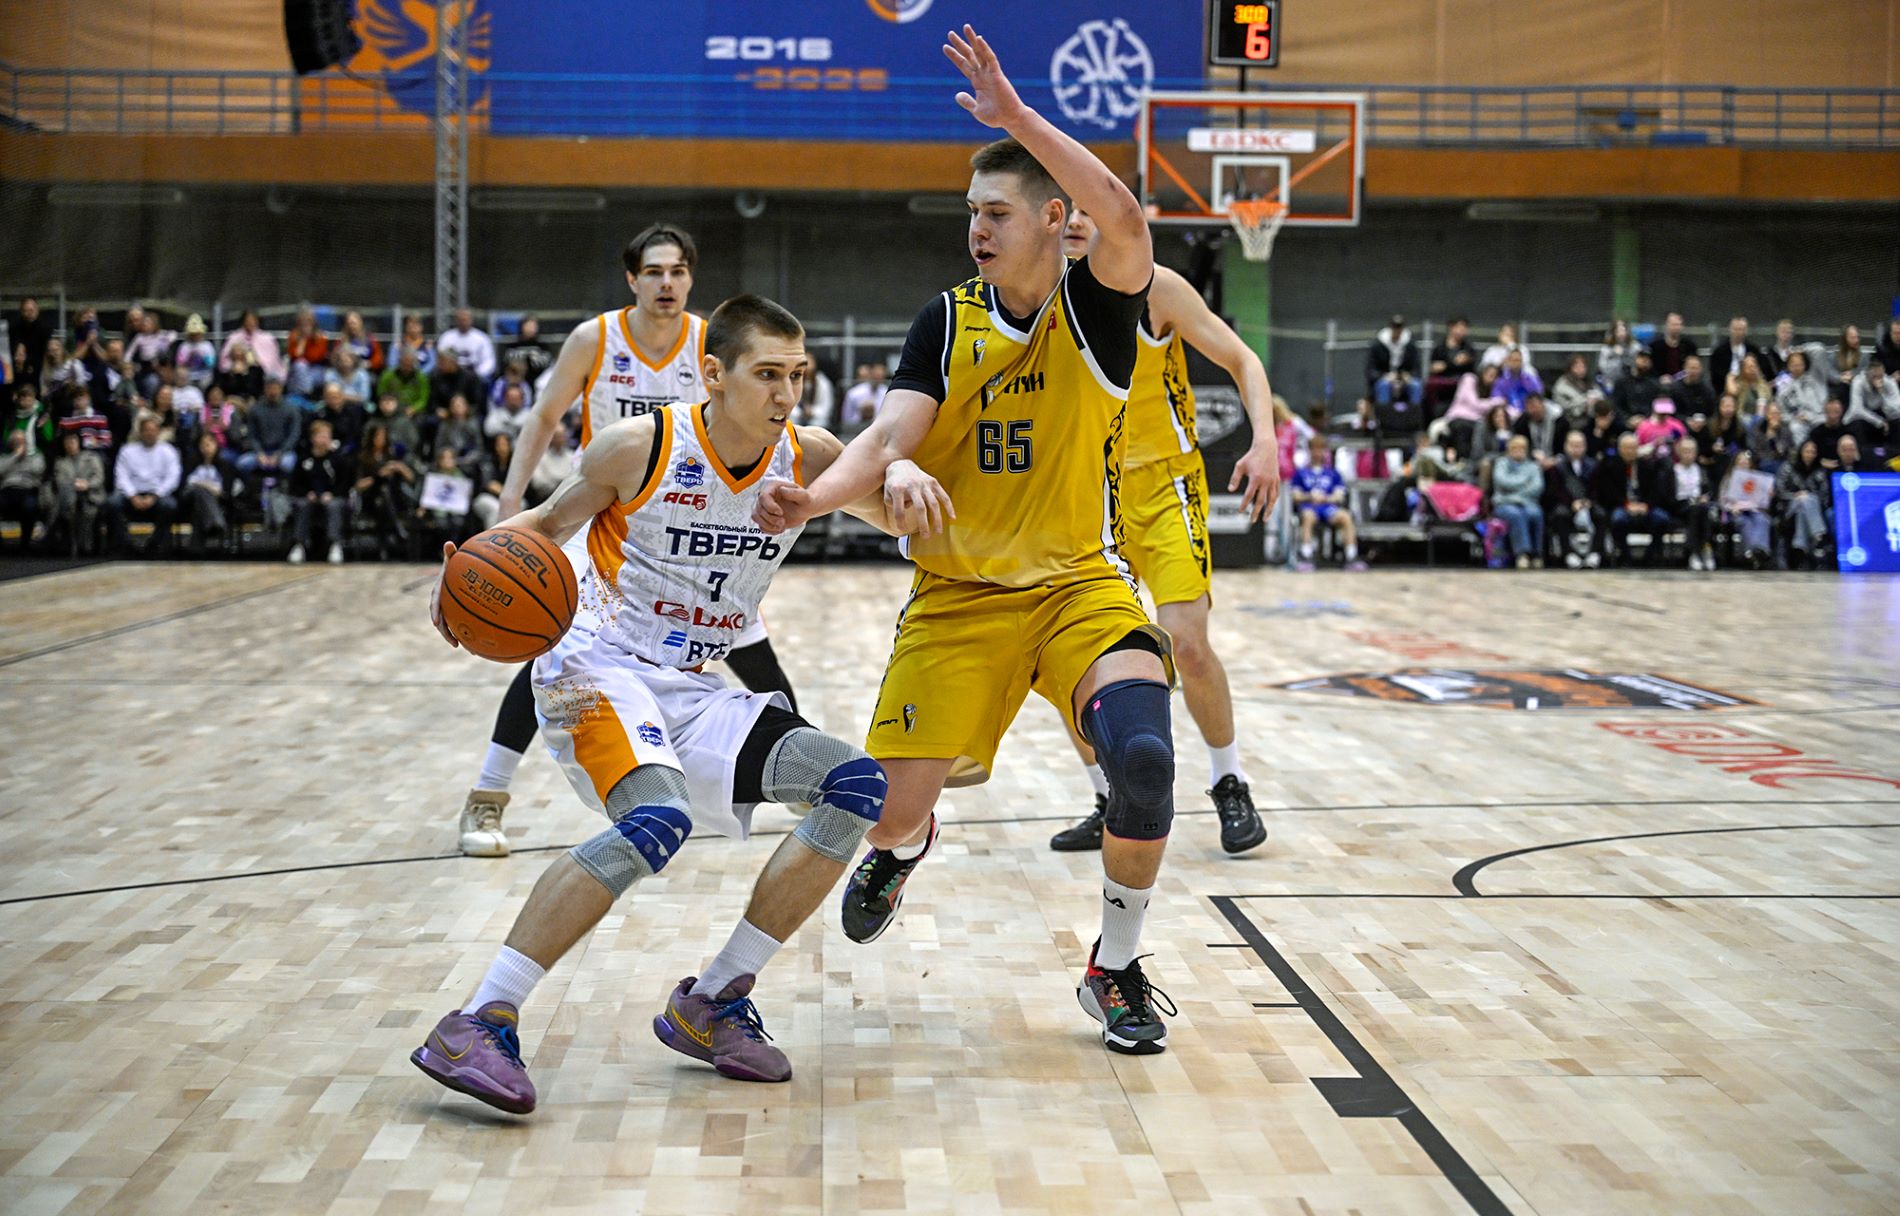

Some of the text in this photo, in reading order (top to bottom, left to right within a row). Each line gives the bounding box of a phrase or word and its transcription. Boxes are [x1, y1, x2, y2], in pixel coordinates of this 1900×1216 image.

[705, 36, 832, 61] 2016
[1245, 23, 1270, 60] 6
[976, 420, 1034, 473] 65
[663, 492, 707, 510] АСБ
[665, 526, 781, 561] ТВЕРЬ
[690, 521, 766, 535] БАСКЕТБОЛЬНЫЙ КЛУ
[707, 570, 729, 602] 7
